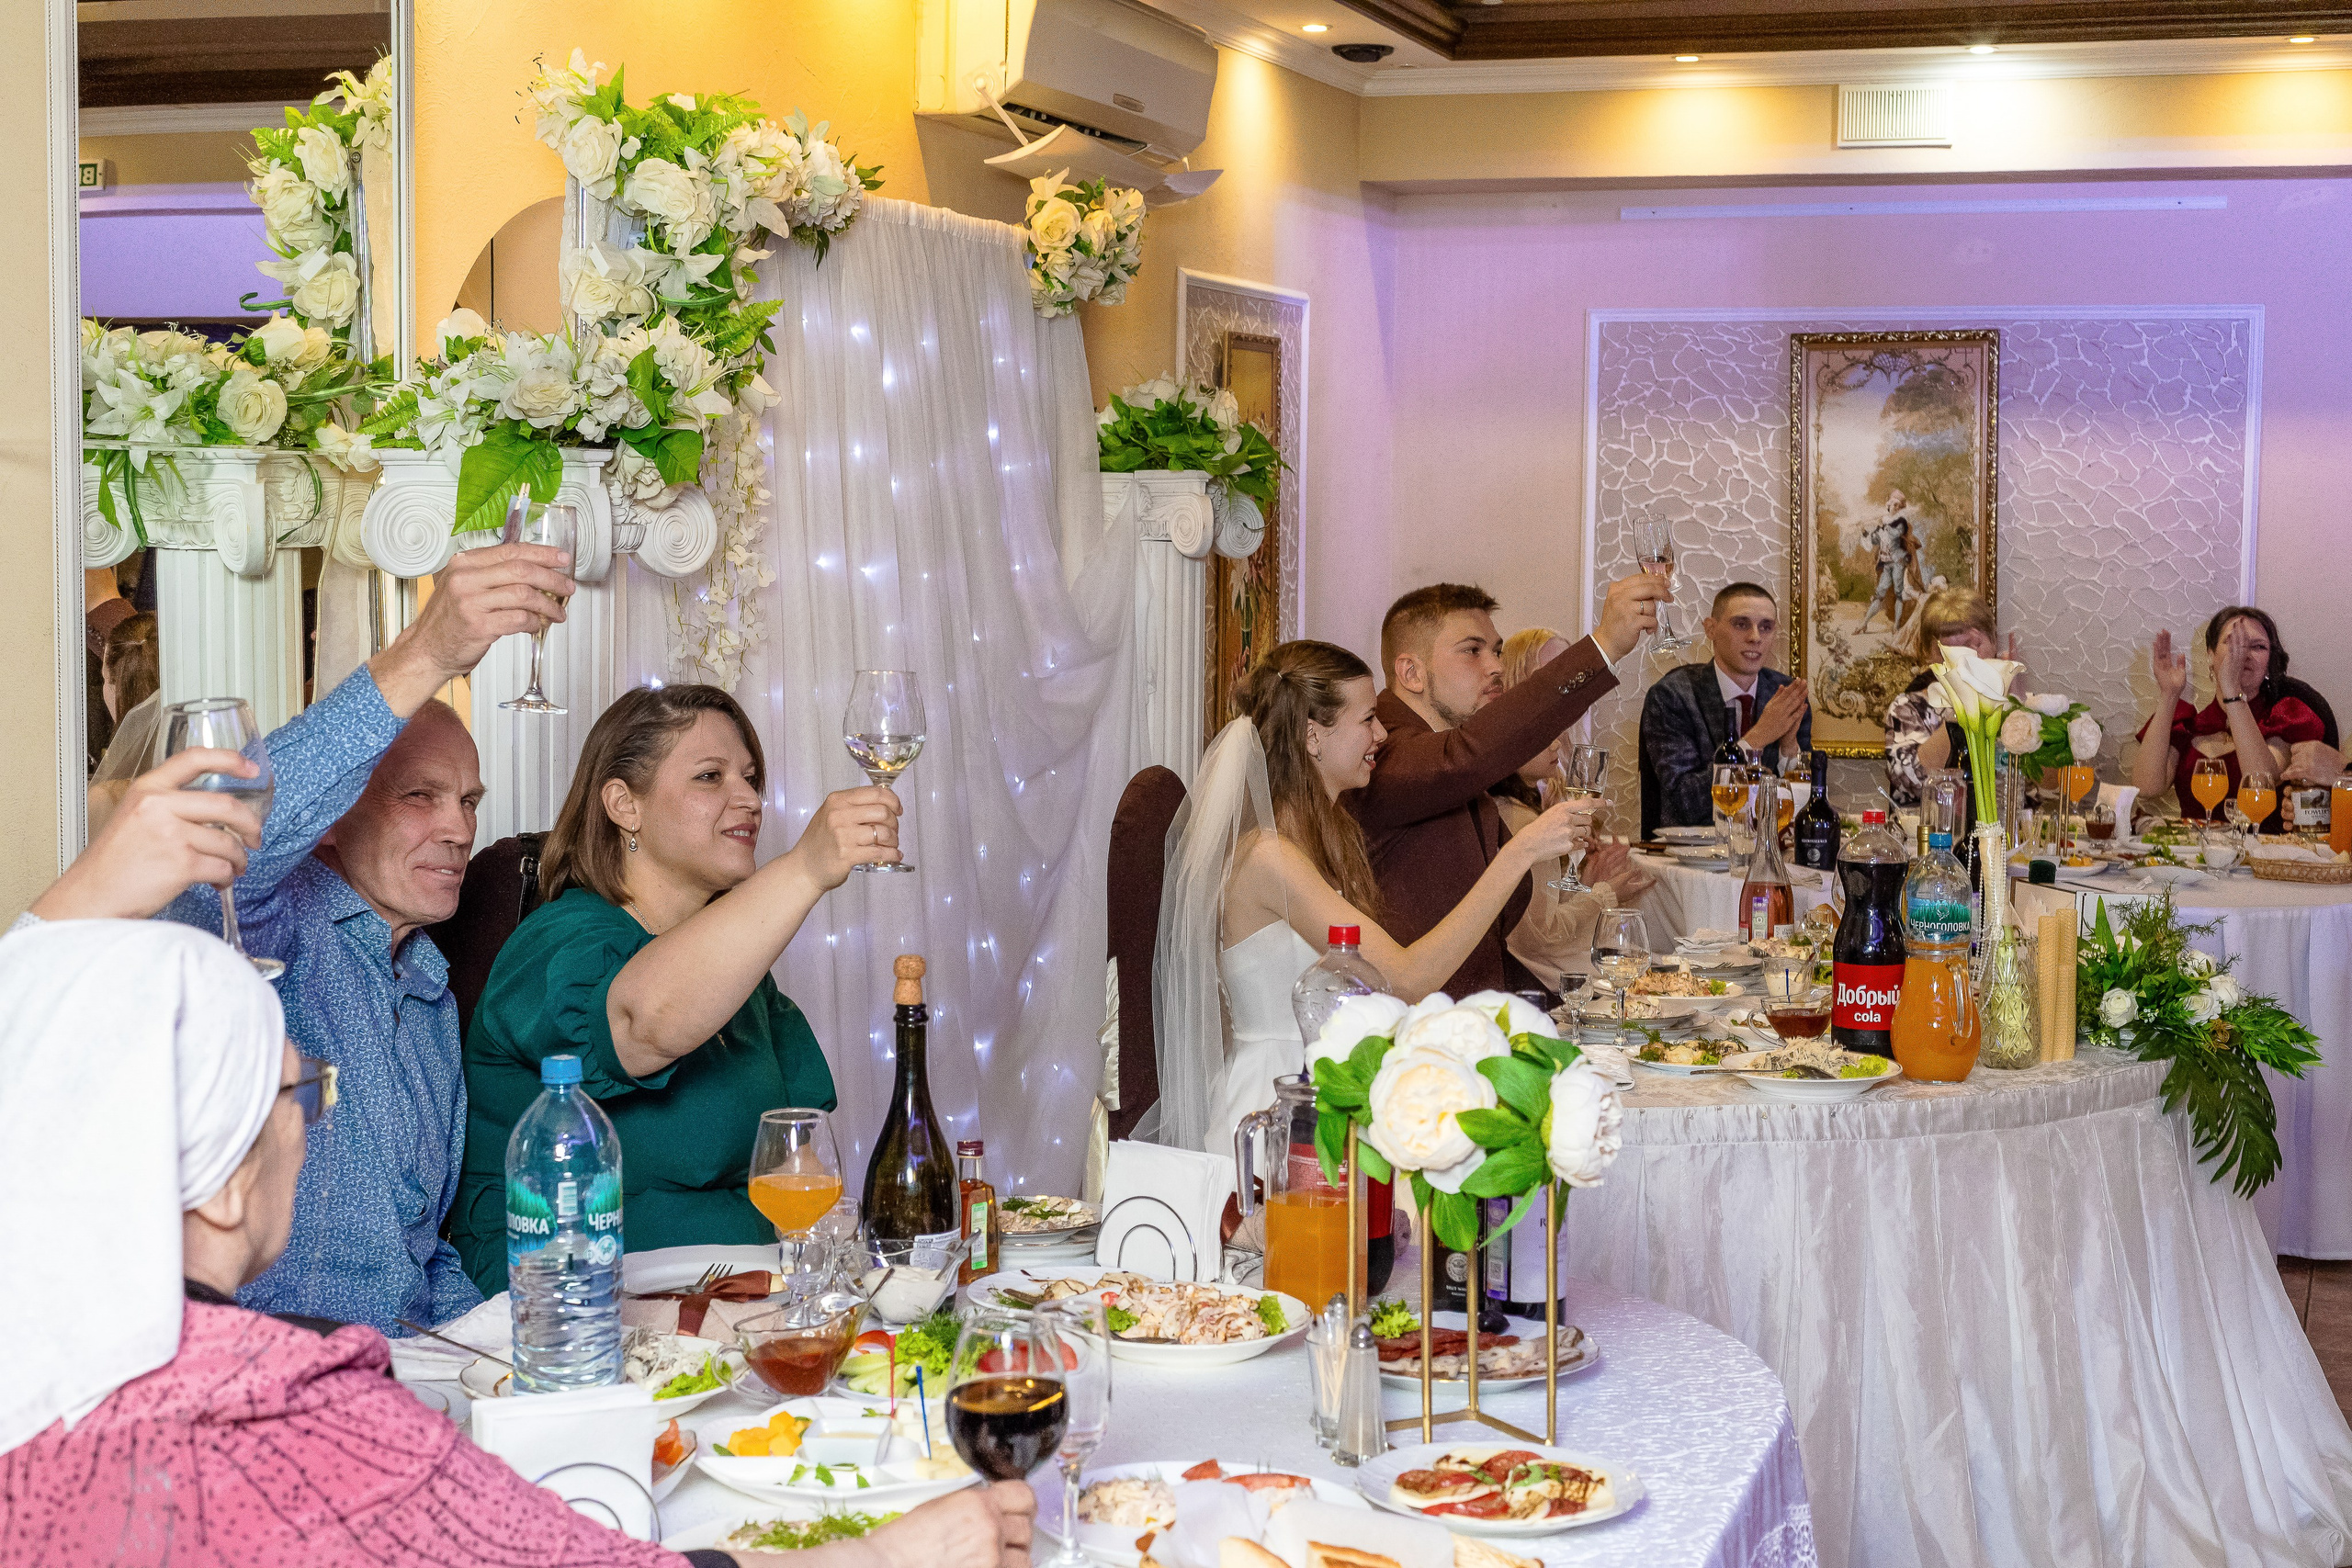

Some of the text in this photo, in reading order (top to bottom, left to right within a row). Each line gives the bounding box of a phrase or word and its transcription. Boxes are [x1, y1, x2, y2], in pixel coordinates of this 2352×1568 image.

[1911, 919, 1971, 932] ЧЕРНОГОЛОВКА
[1838, 982, 1901, 1009] Добрый
[1854, 1010, 1882, 1022] cola
